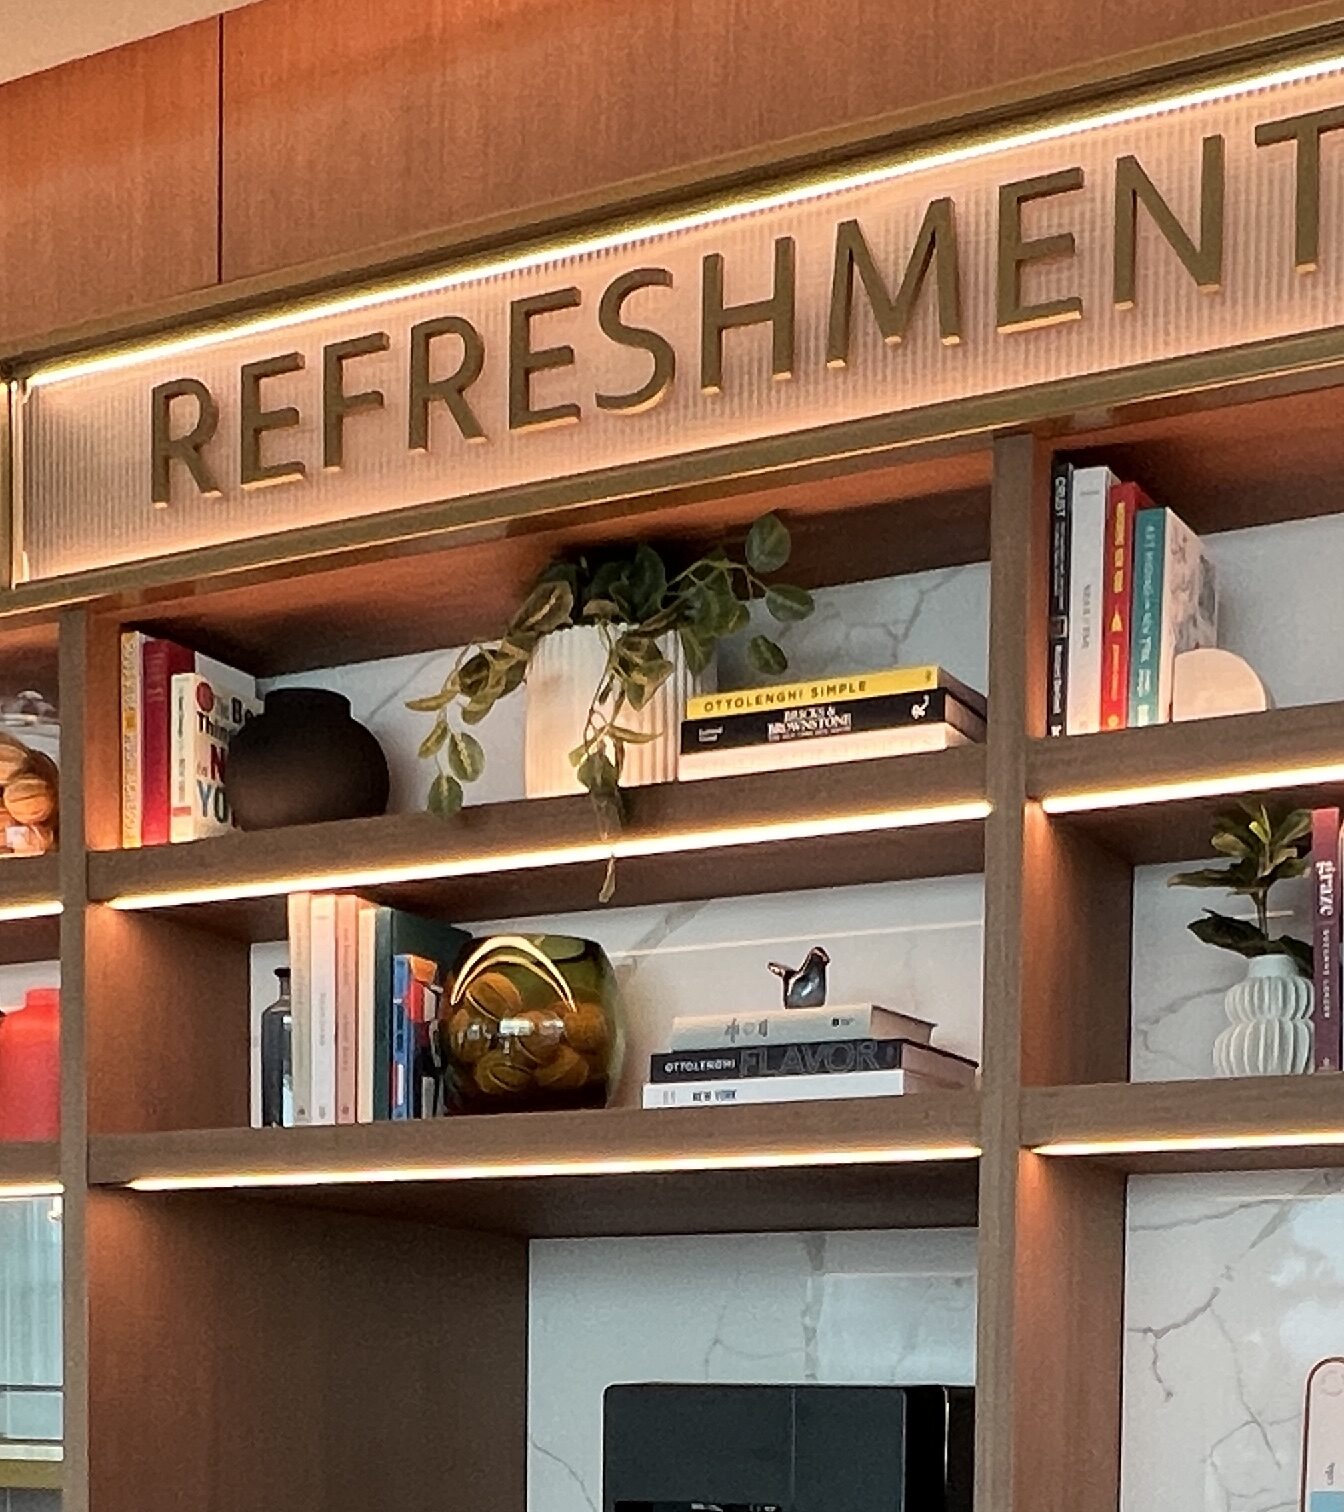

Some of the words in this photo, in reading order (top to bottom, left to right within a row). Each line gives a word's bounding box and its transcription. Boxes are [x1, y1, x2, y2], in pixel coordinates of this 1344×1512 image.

[704, 690, 803, 712] OTTOLENGHI
[810, 680, 866, 699] SIMPLE
[1315, 860, 1336, 917] graze
[664, 1058, 736, 1073] OTTOLENGHI
[739, 1040, 880, 1077] FLAVOR
